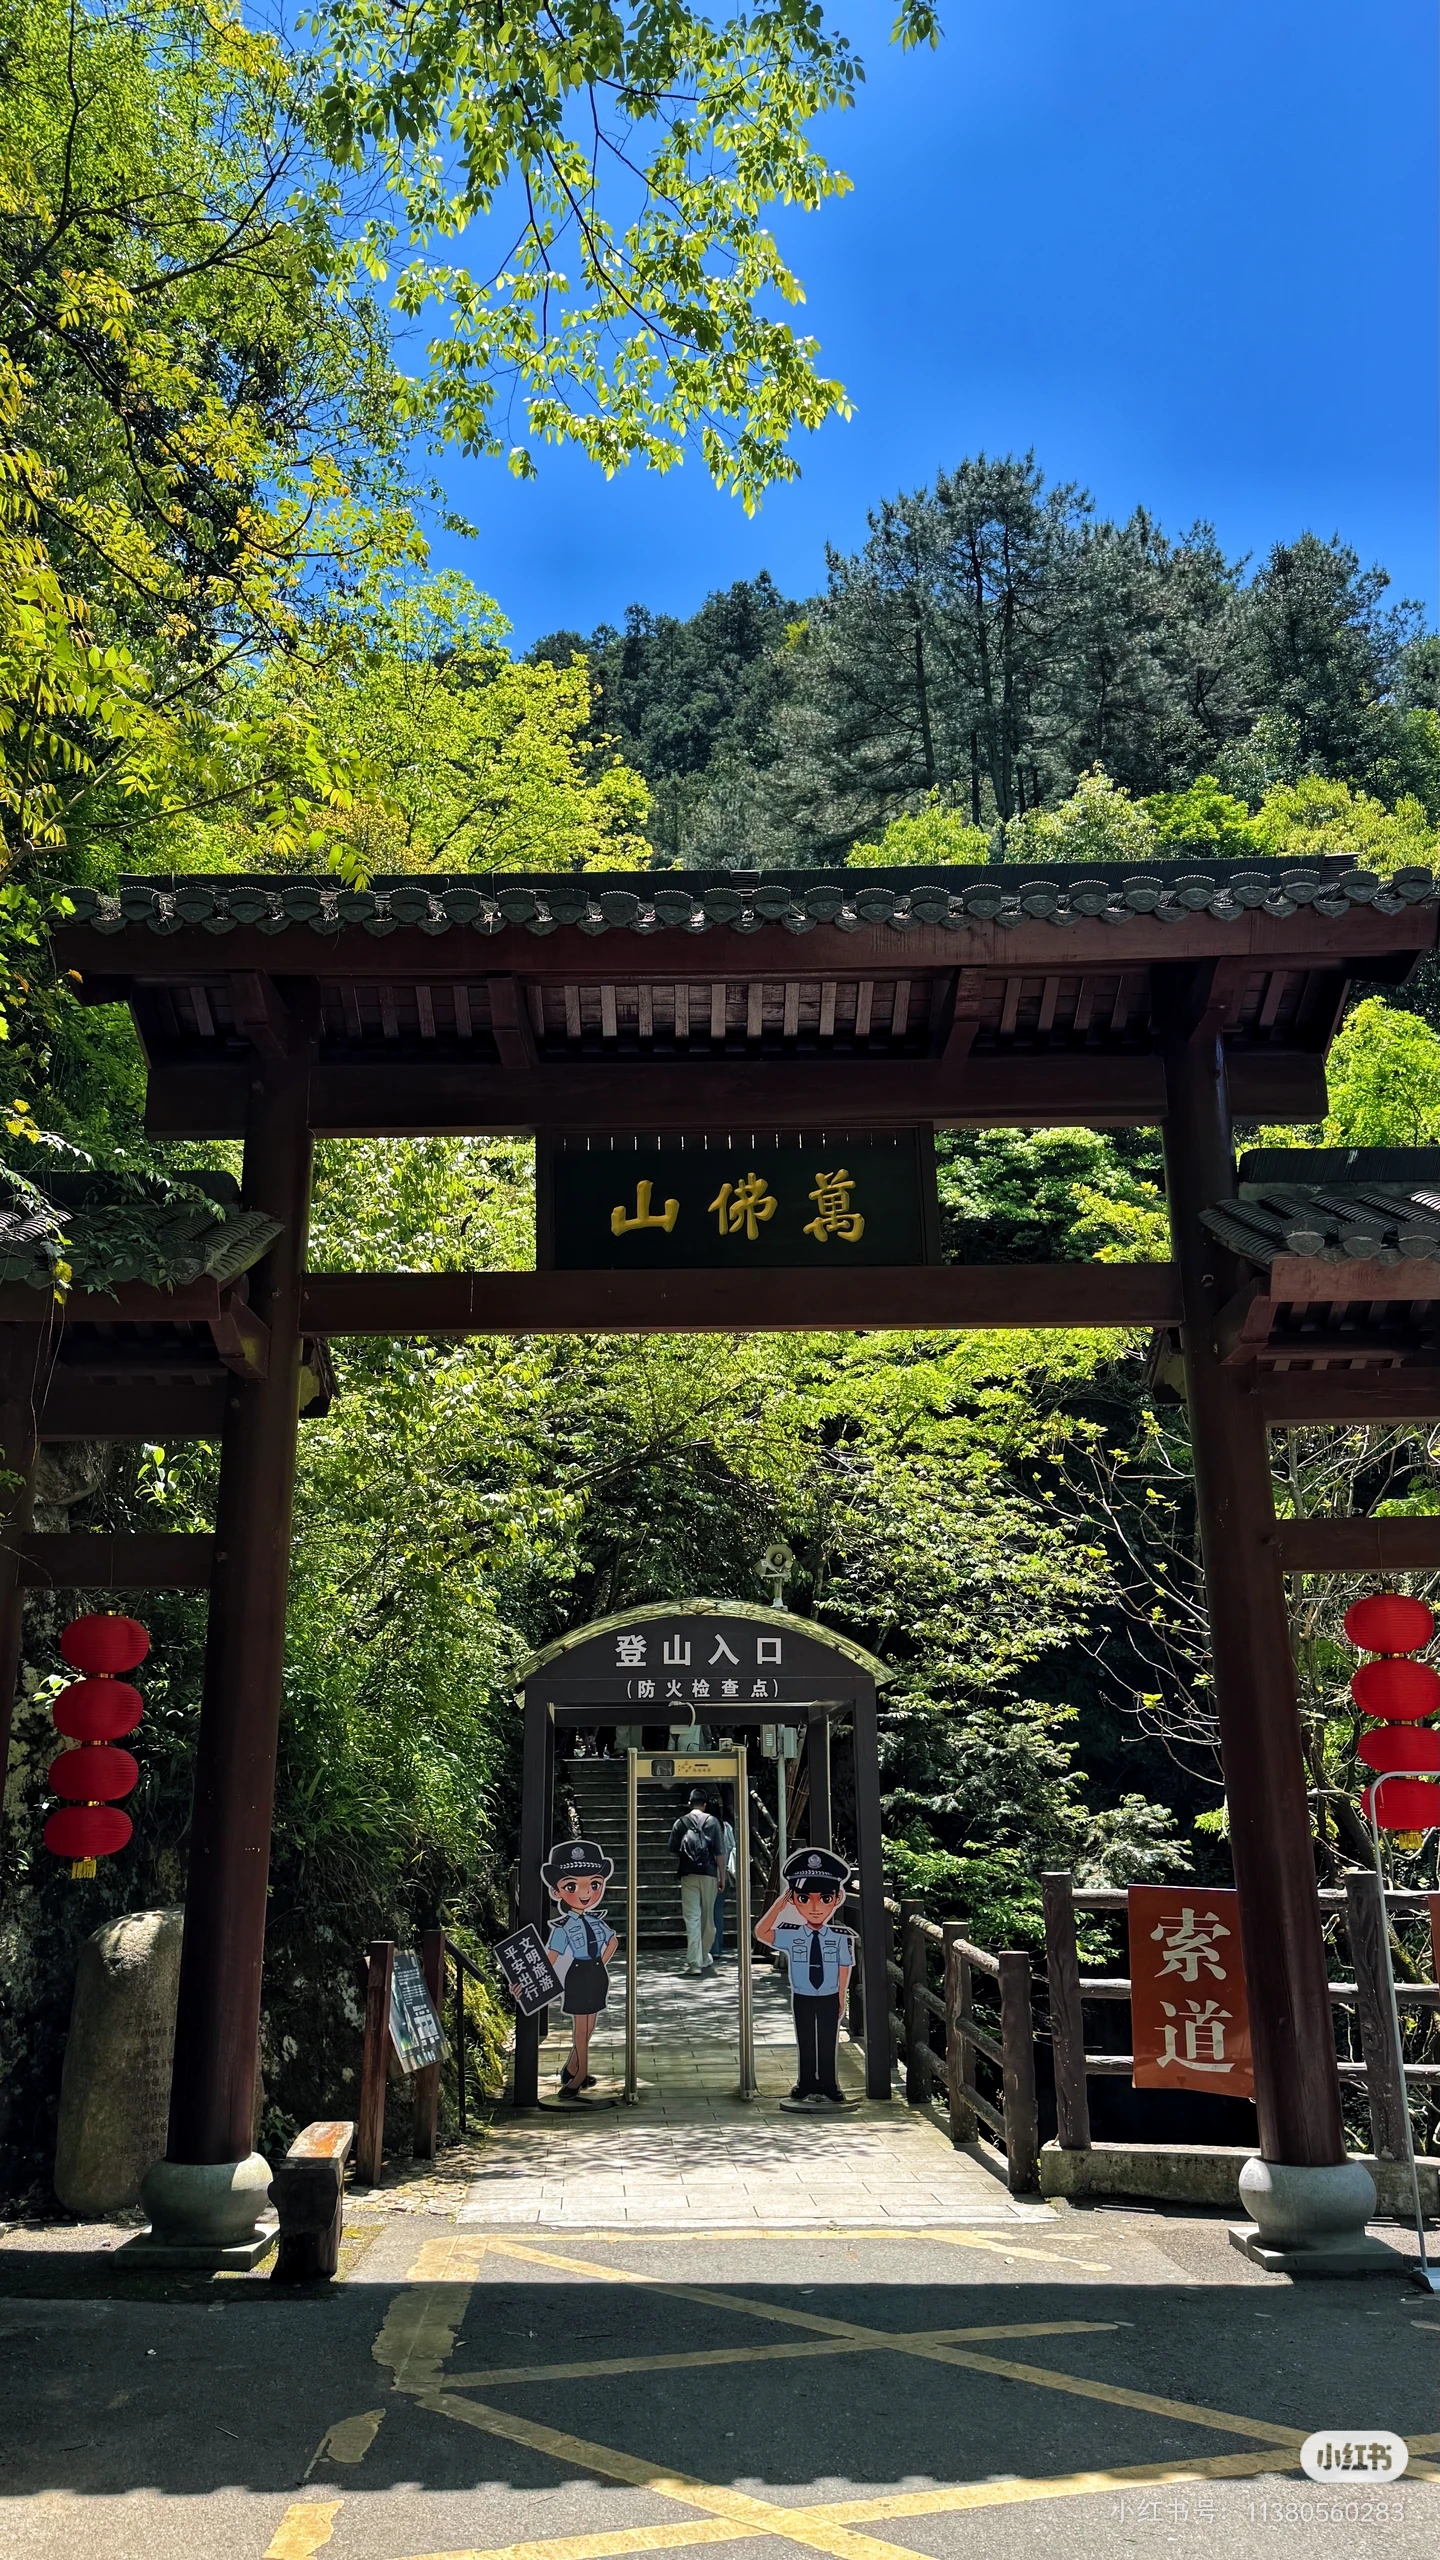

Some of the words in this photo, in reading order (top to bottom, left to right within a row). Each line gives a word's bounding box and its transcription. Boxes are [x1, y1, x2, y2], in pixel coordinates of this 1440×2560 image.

[615, 1634, 783, 1667] 登山入口
[627, 1679, 778, 1699] (防火检查点)
[503, 1944, 540, 2002] 平安出行
[518, 1936, 554, 1992] 文明旅游
[1150, 1907, 1236, 2073] 索道
